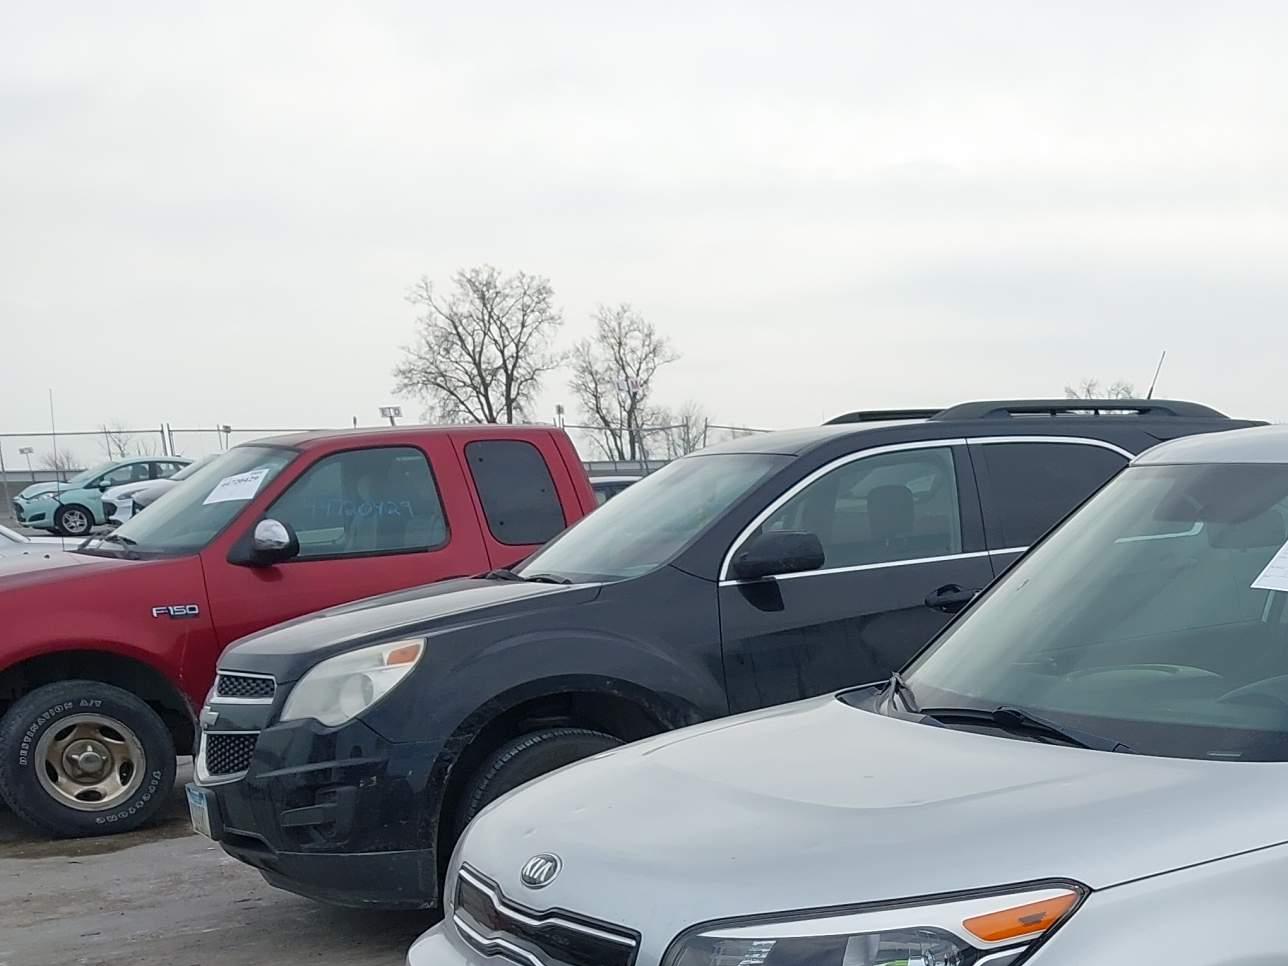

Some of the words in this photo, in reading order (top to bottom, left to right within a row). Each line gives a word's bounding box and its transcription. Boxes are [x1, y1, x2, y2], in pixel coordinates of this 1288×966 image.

[152, 604, 199, 618] F150
[19, 701, 74, 766] DESTINATION
[79, 699, 103, 708] A/T
[522, 857, 552, 882] KIA
